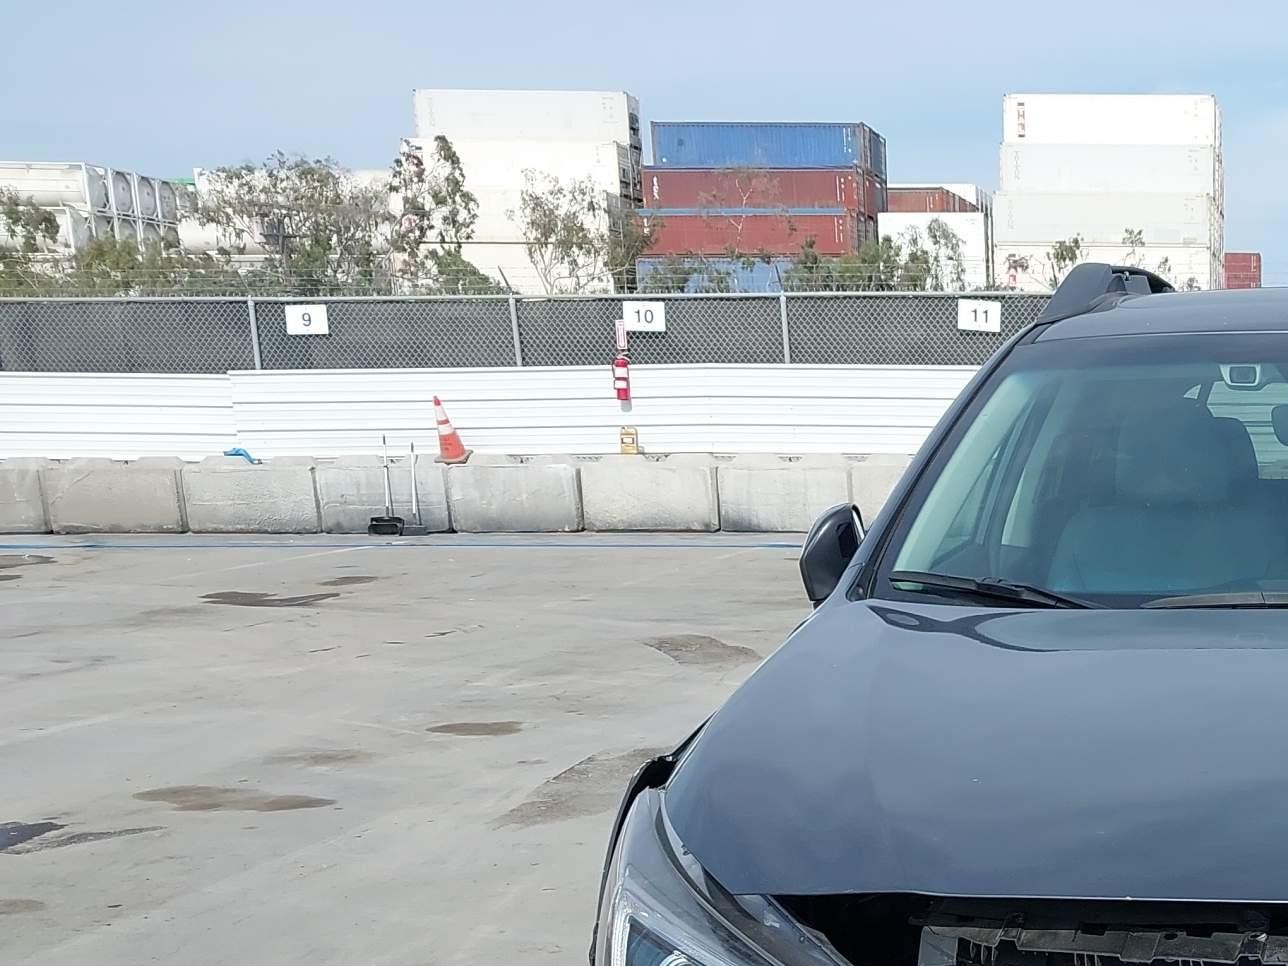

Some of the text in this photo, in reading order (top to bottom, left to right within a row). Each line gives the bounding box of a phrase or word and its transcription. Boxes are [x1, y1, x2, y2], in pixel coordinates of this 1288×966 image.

[303, 312, 312, 327] 9
[635, 309, 654, 324] 10
[973, 308, 988, 323] 11
